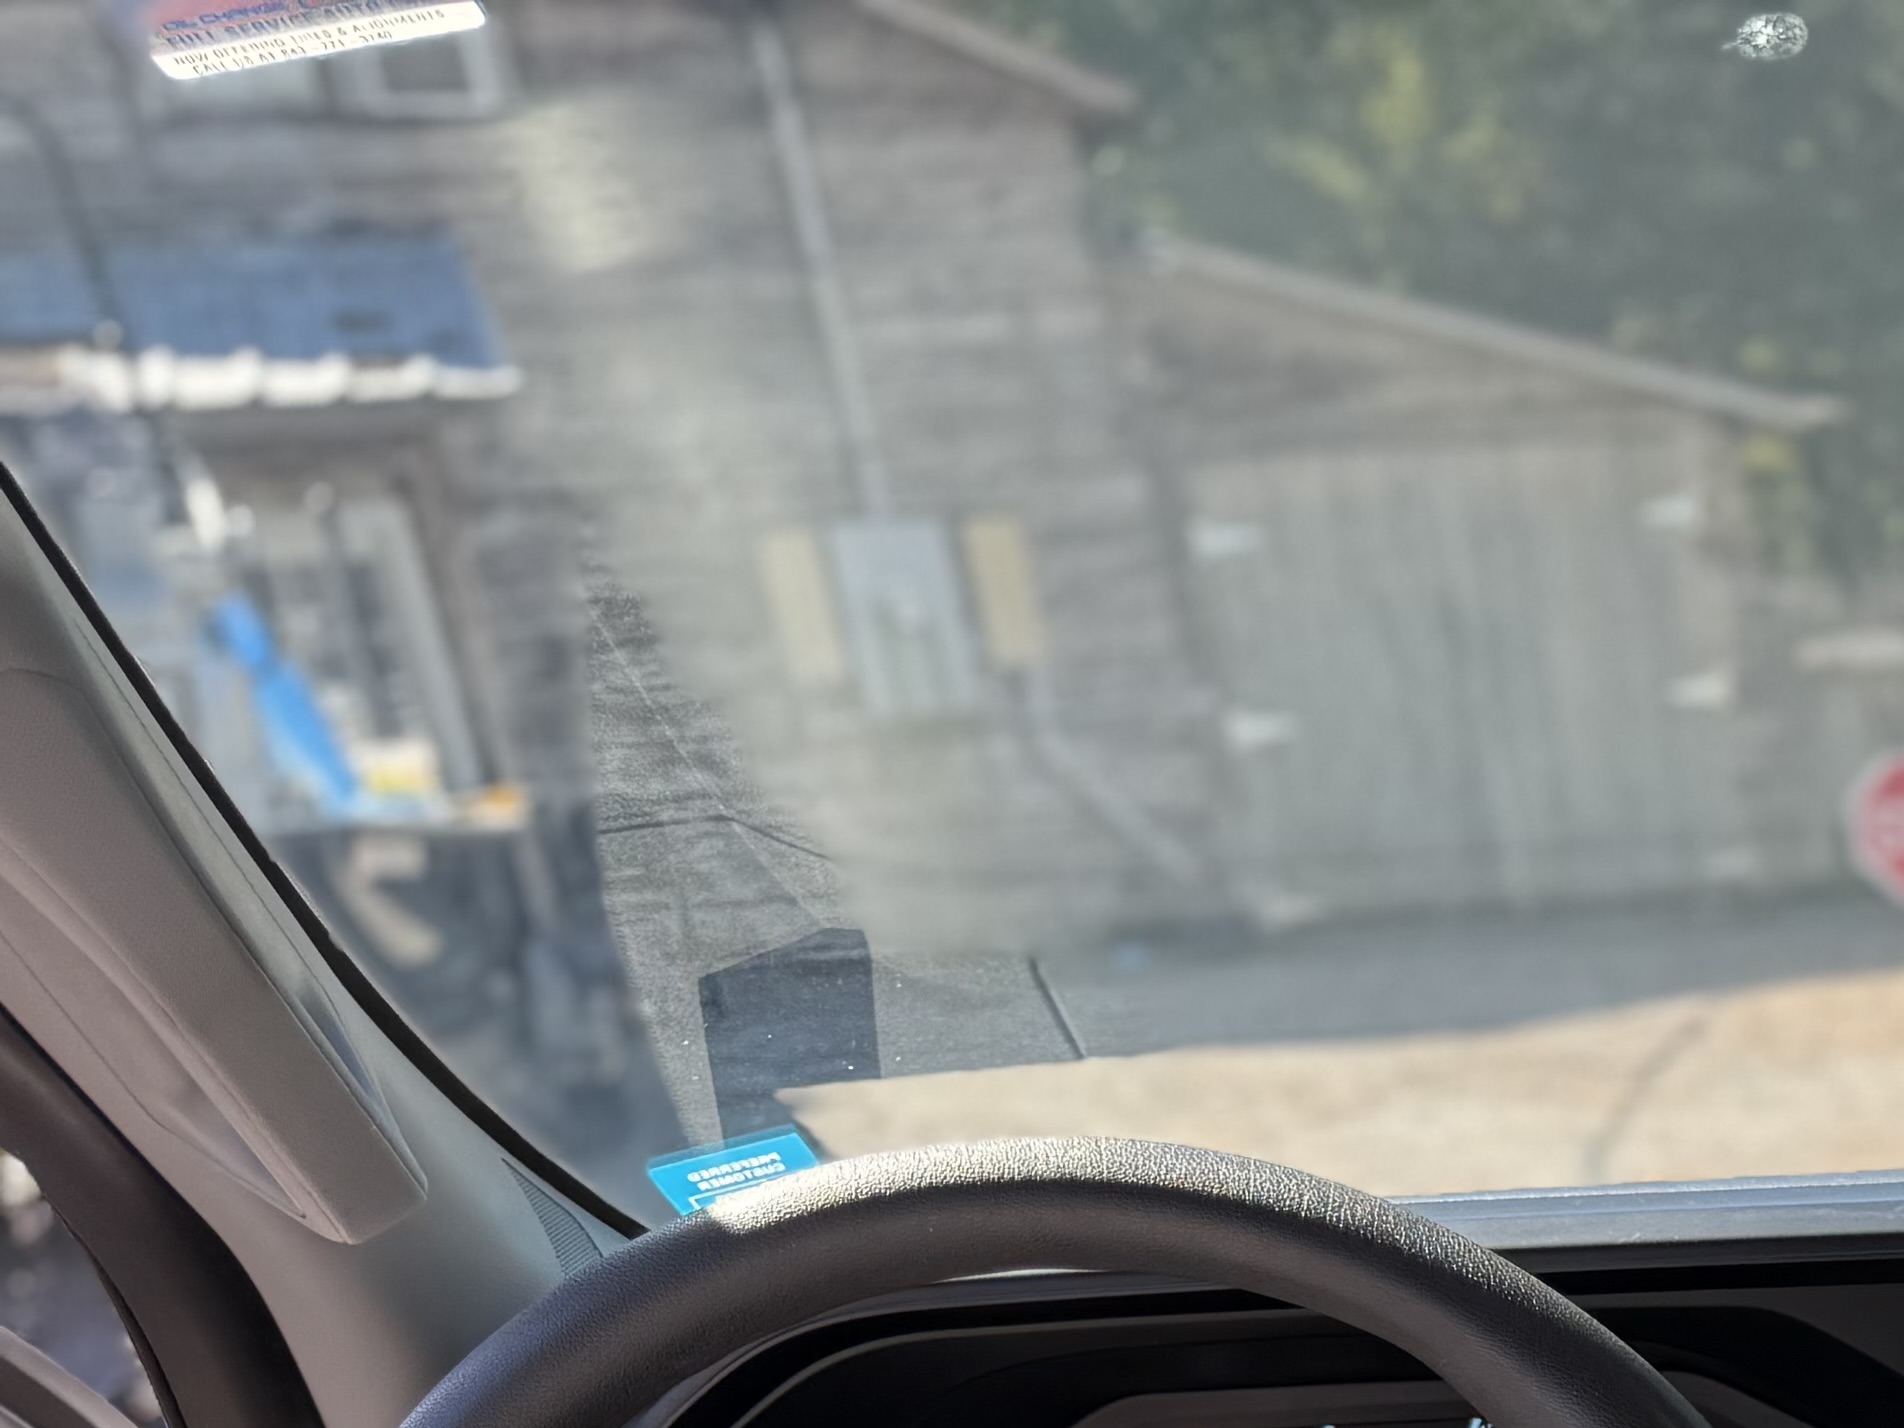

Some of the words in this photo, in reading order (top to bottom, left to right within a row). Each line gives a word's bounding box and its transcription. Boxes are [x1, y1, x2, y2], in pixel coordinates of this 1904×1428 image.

[174, 53, 209, 65] NOW
[212, 38, 284, 58] OFFERING
[192, 61, 228, 76] CALL
